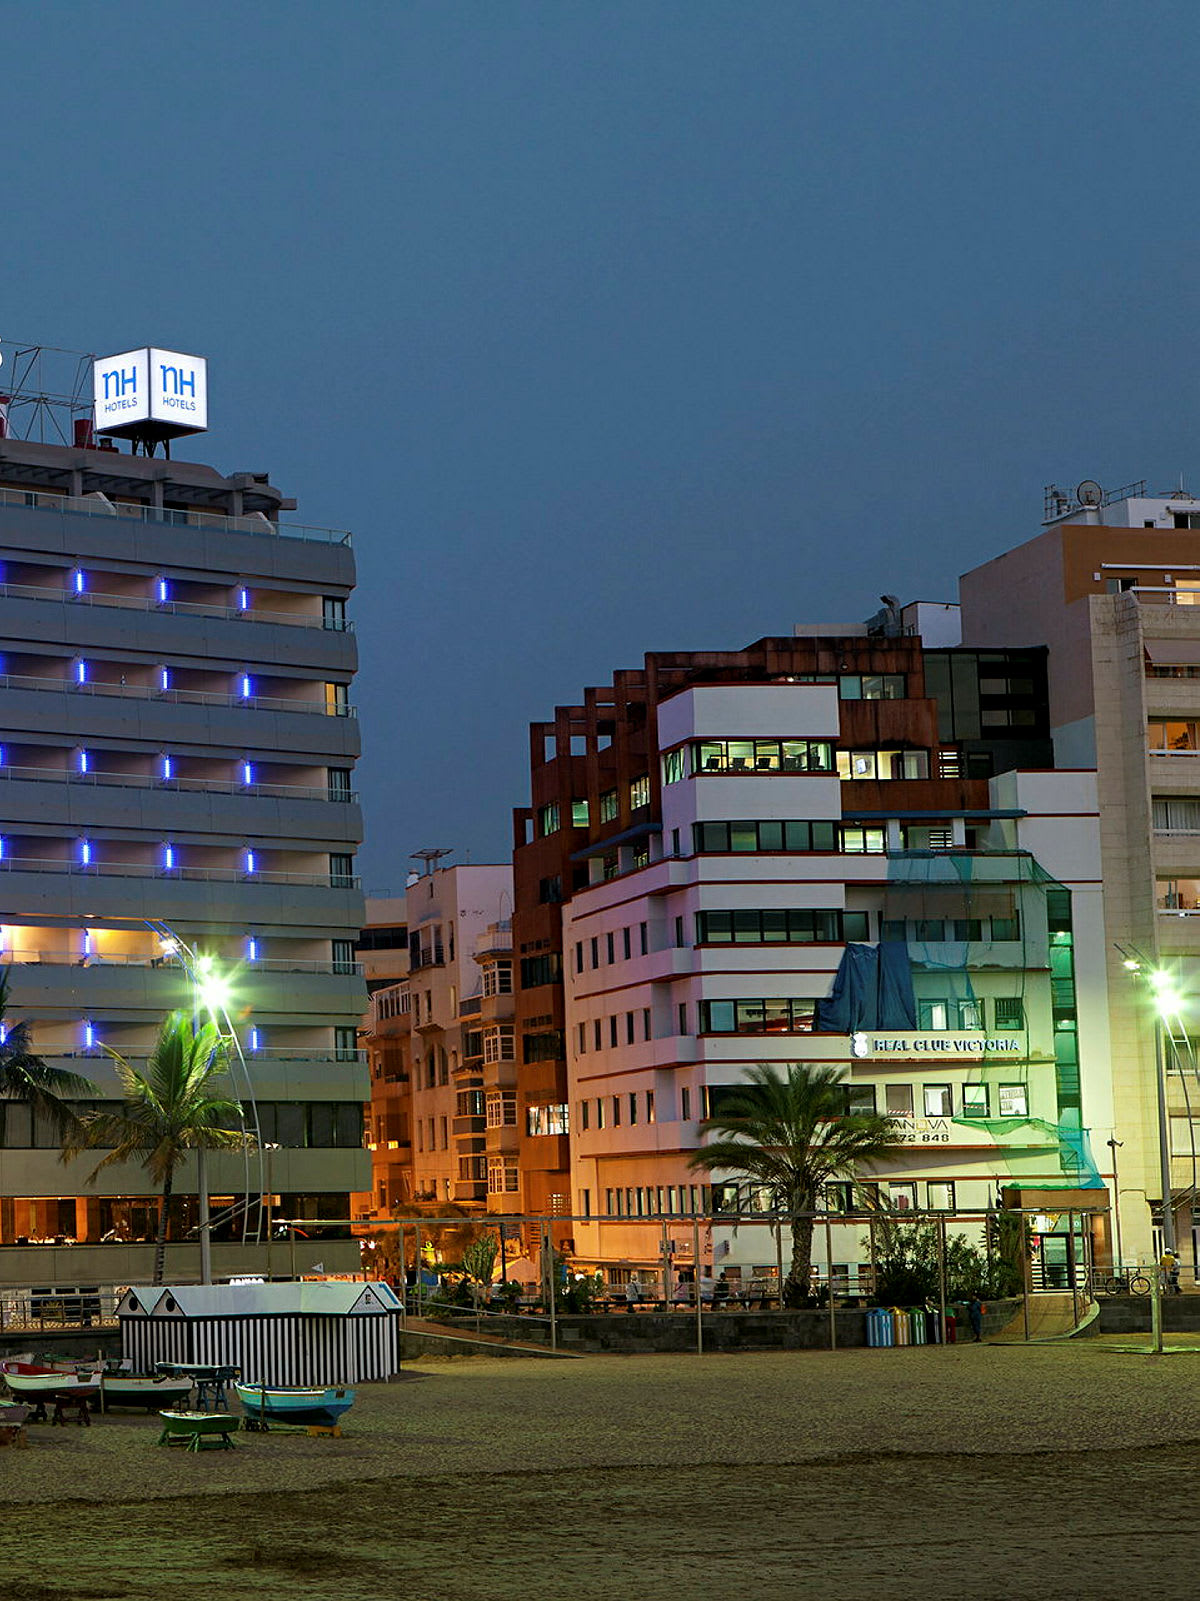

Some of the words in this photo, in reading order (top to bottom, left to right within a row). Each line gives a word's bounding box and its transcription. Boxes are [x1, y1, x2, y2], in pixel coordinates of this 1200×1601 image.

[105, 397, 138, 413] HOTELS
[163, 397, 196, 411] HOTELS
[873, 1039, 911, 1051] REAL
[953, 1039, 1020, 1051] VICTORIA
